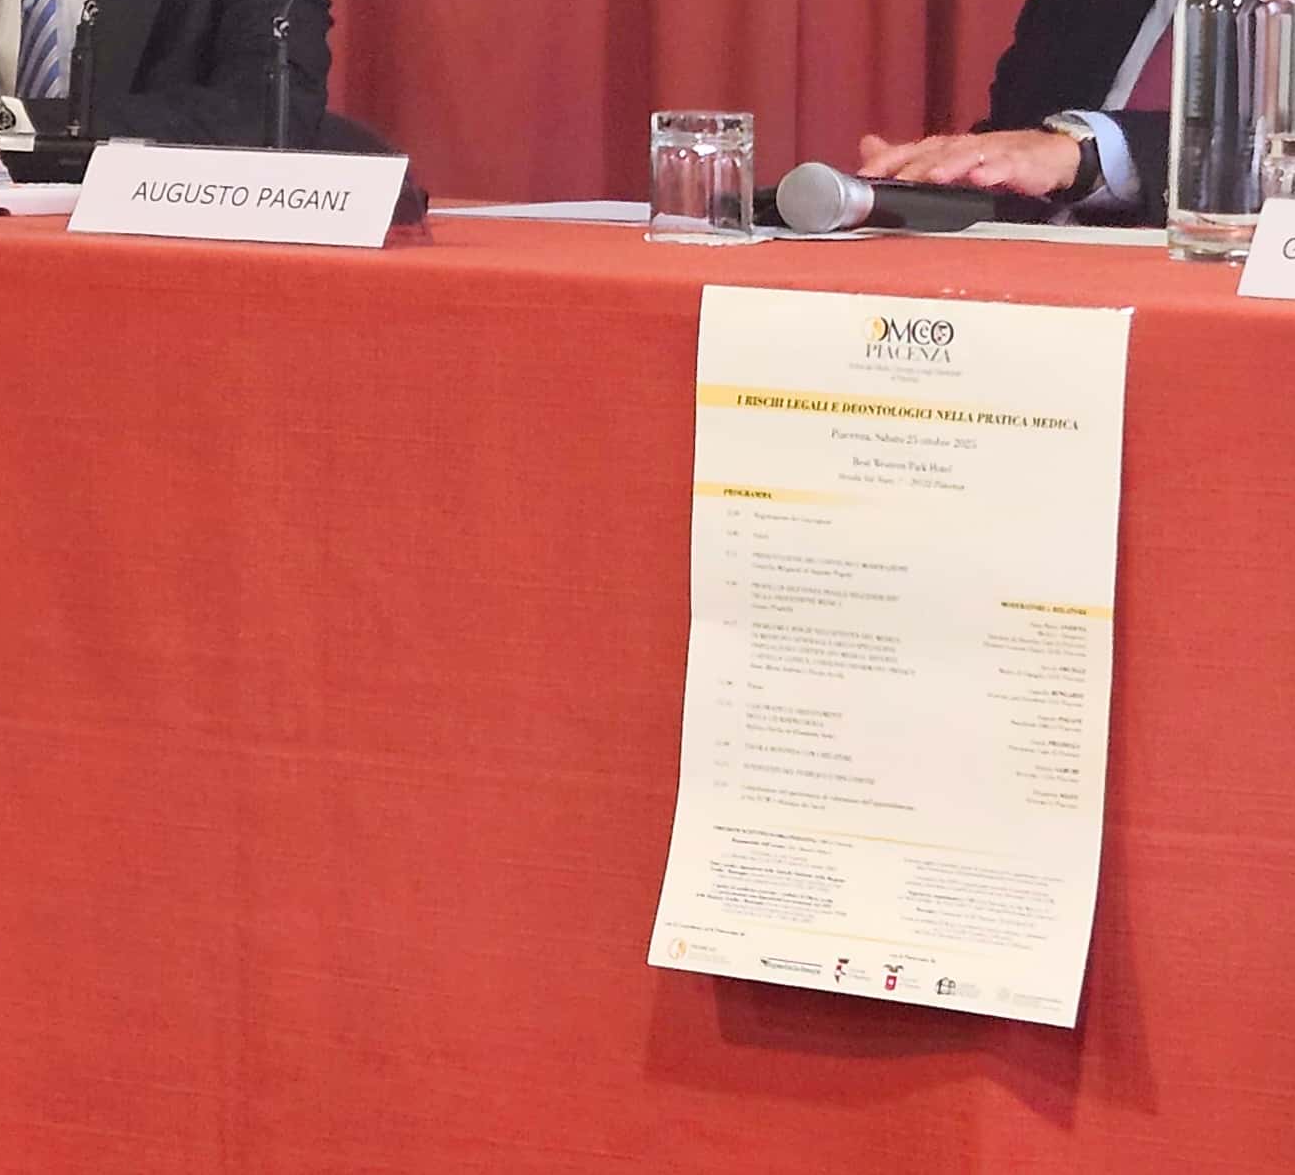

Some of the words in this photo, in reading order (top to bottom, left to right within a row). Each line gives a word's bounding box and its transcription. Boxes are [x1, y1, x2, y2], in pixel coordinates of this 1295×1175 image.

[131, 181, 249, 207] AUGUSTO
[256, 187, 351, 212] PAGANI
[866, 343, 951, 363] PIACENZA
[745, 395, 784, 408] RISCHI
[786, 398, 829, 412] LEGALI
[831, 401, 839, 412] E
[841, 402, 932, 420] DEONTOLOGICI
[936, 409, 974, 423] NELLA
[976, 412, 1028, 427] PRATICA
[1031, 416, 1079, 431] MEDICA
